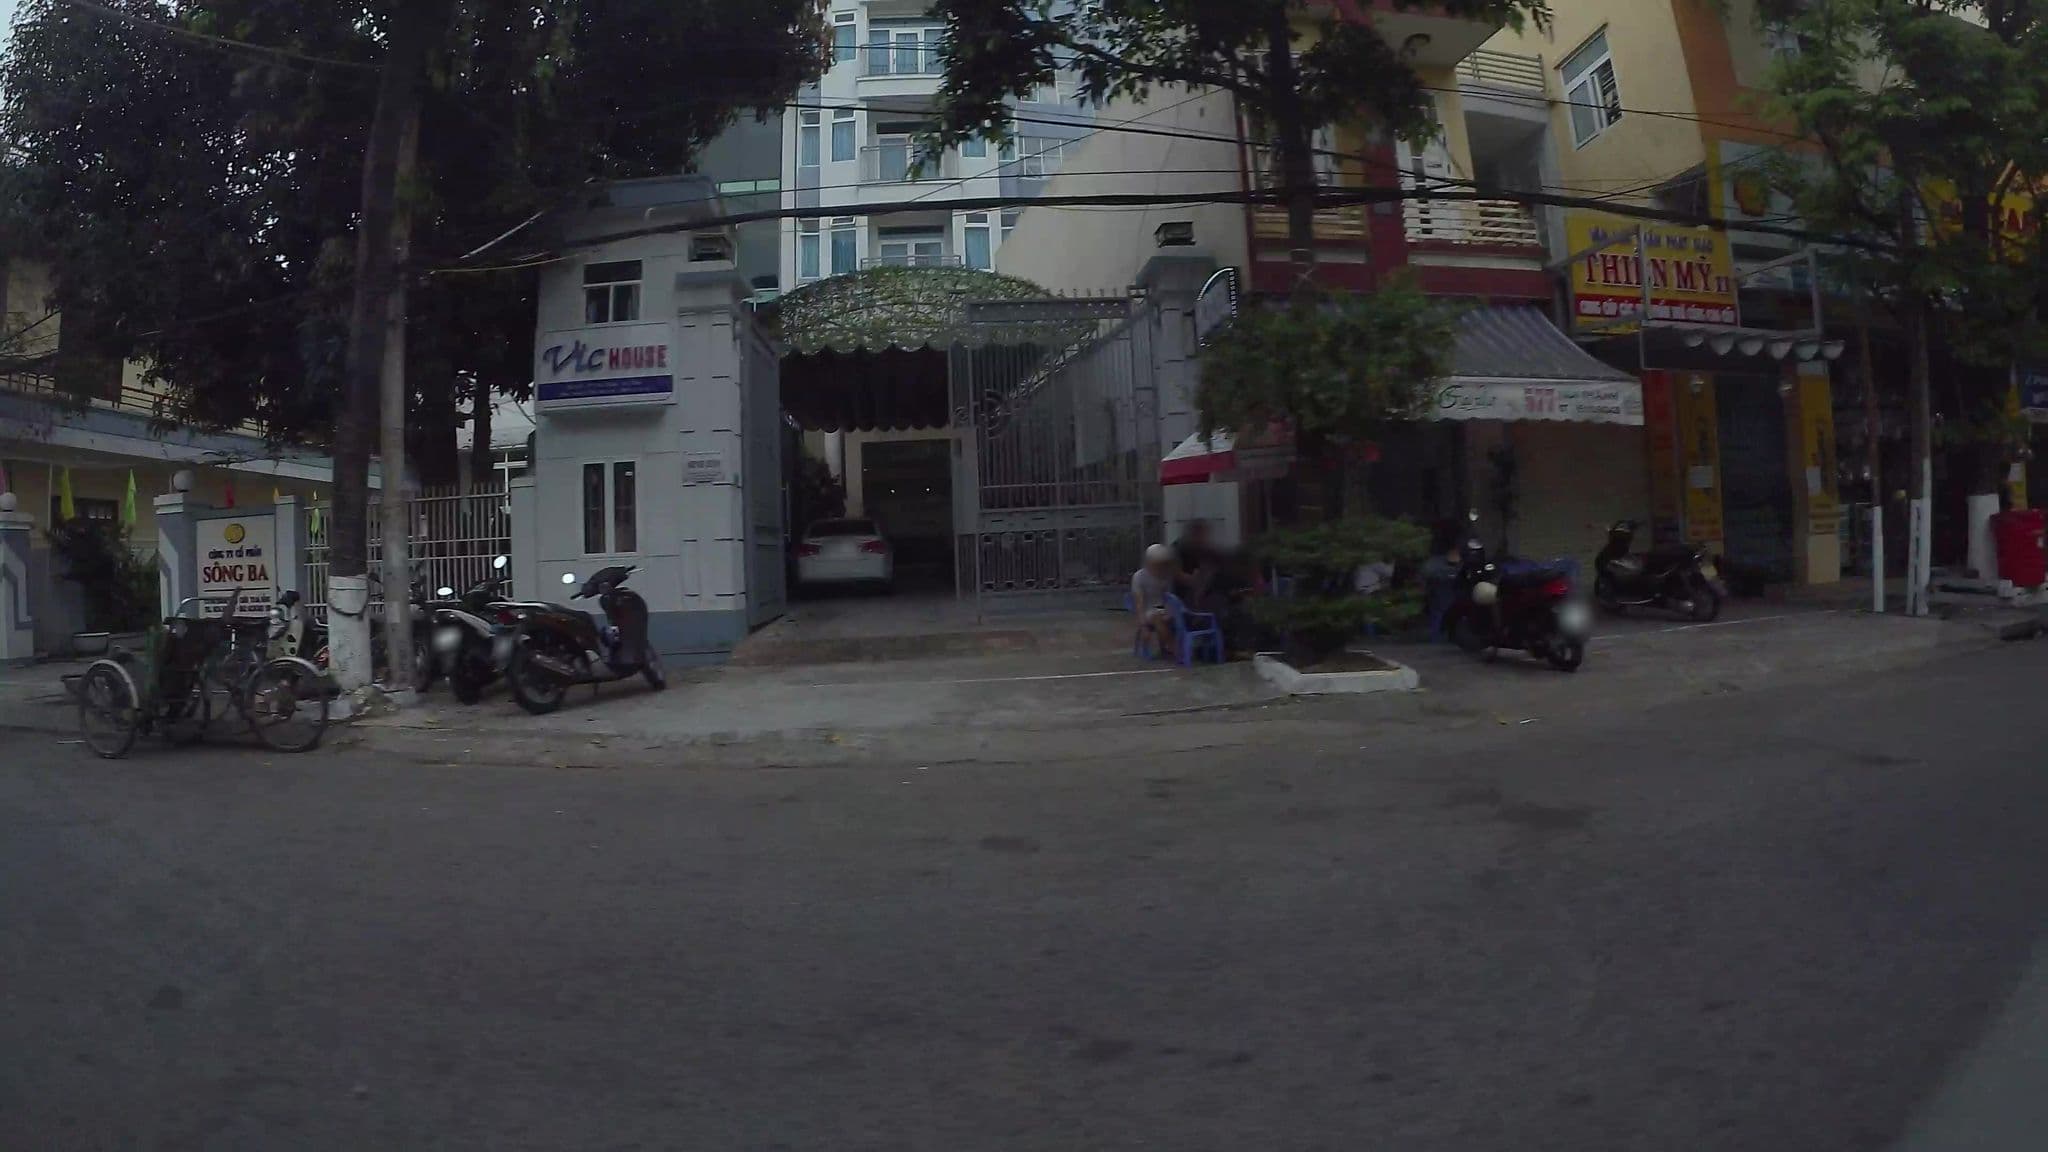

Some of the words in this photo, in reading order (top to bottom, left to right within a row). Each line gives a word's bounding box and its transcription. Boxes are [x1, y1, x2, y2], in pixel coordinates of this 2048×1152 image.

[609, 345, 667, 370] HOUSE
[203, 560, 244, 583] SÔNG
[248, 564, 269, 582] BA
